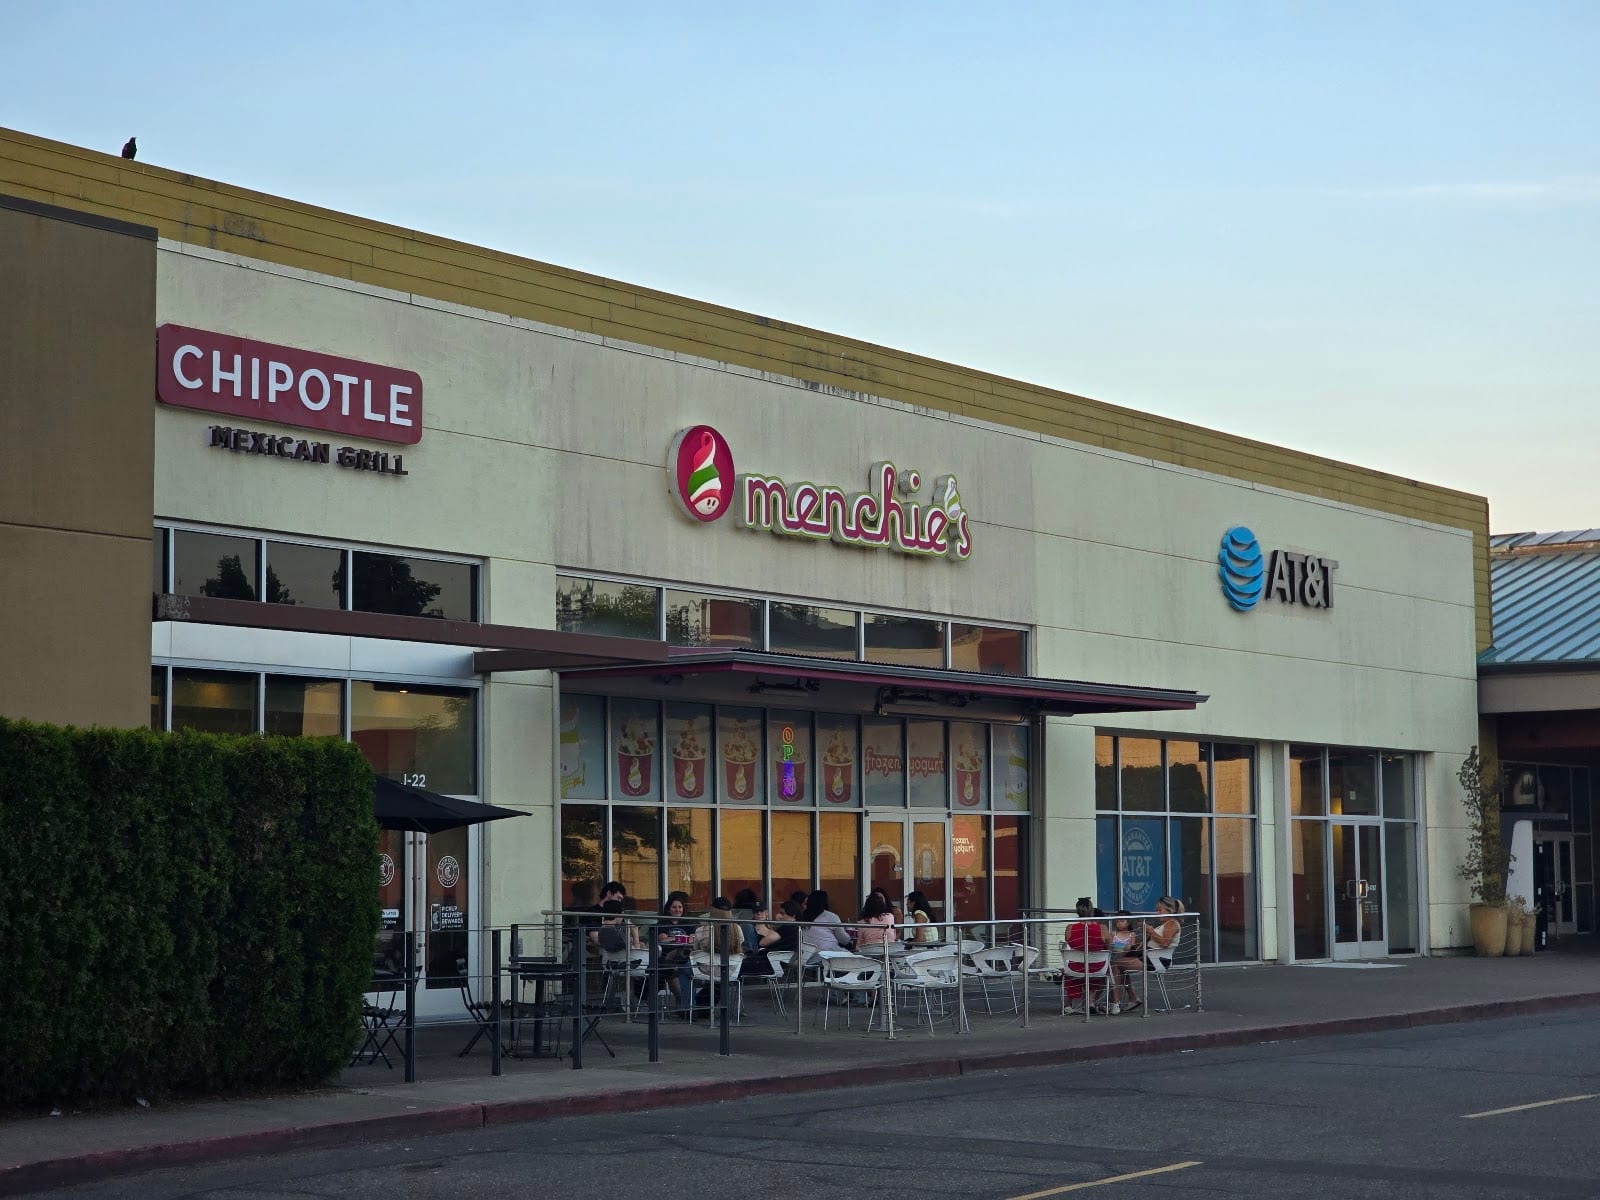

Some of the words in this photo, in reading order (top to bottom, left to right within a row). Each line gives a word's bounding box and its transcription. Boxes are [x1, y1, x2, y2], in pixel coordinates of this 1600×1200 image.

[172, 344, 413, 427] CHIPOTLE
[208, 425, 330, 463] MEXICAN
[336, 447, 408, 475] GRILL
[742, 460, 972, 560] menchie's
[1264, 549, 1339, 609] AT&T
[864, 746, 902, 777] frozen
[909, 751, 944, 777] yogurt
[952, 834, 970, 845] rozen
[1122, 855, 1152, 877] AT&T
